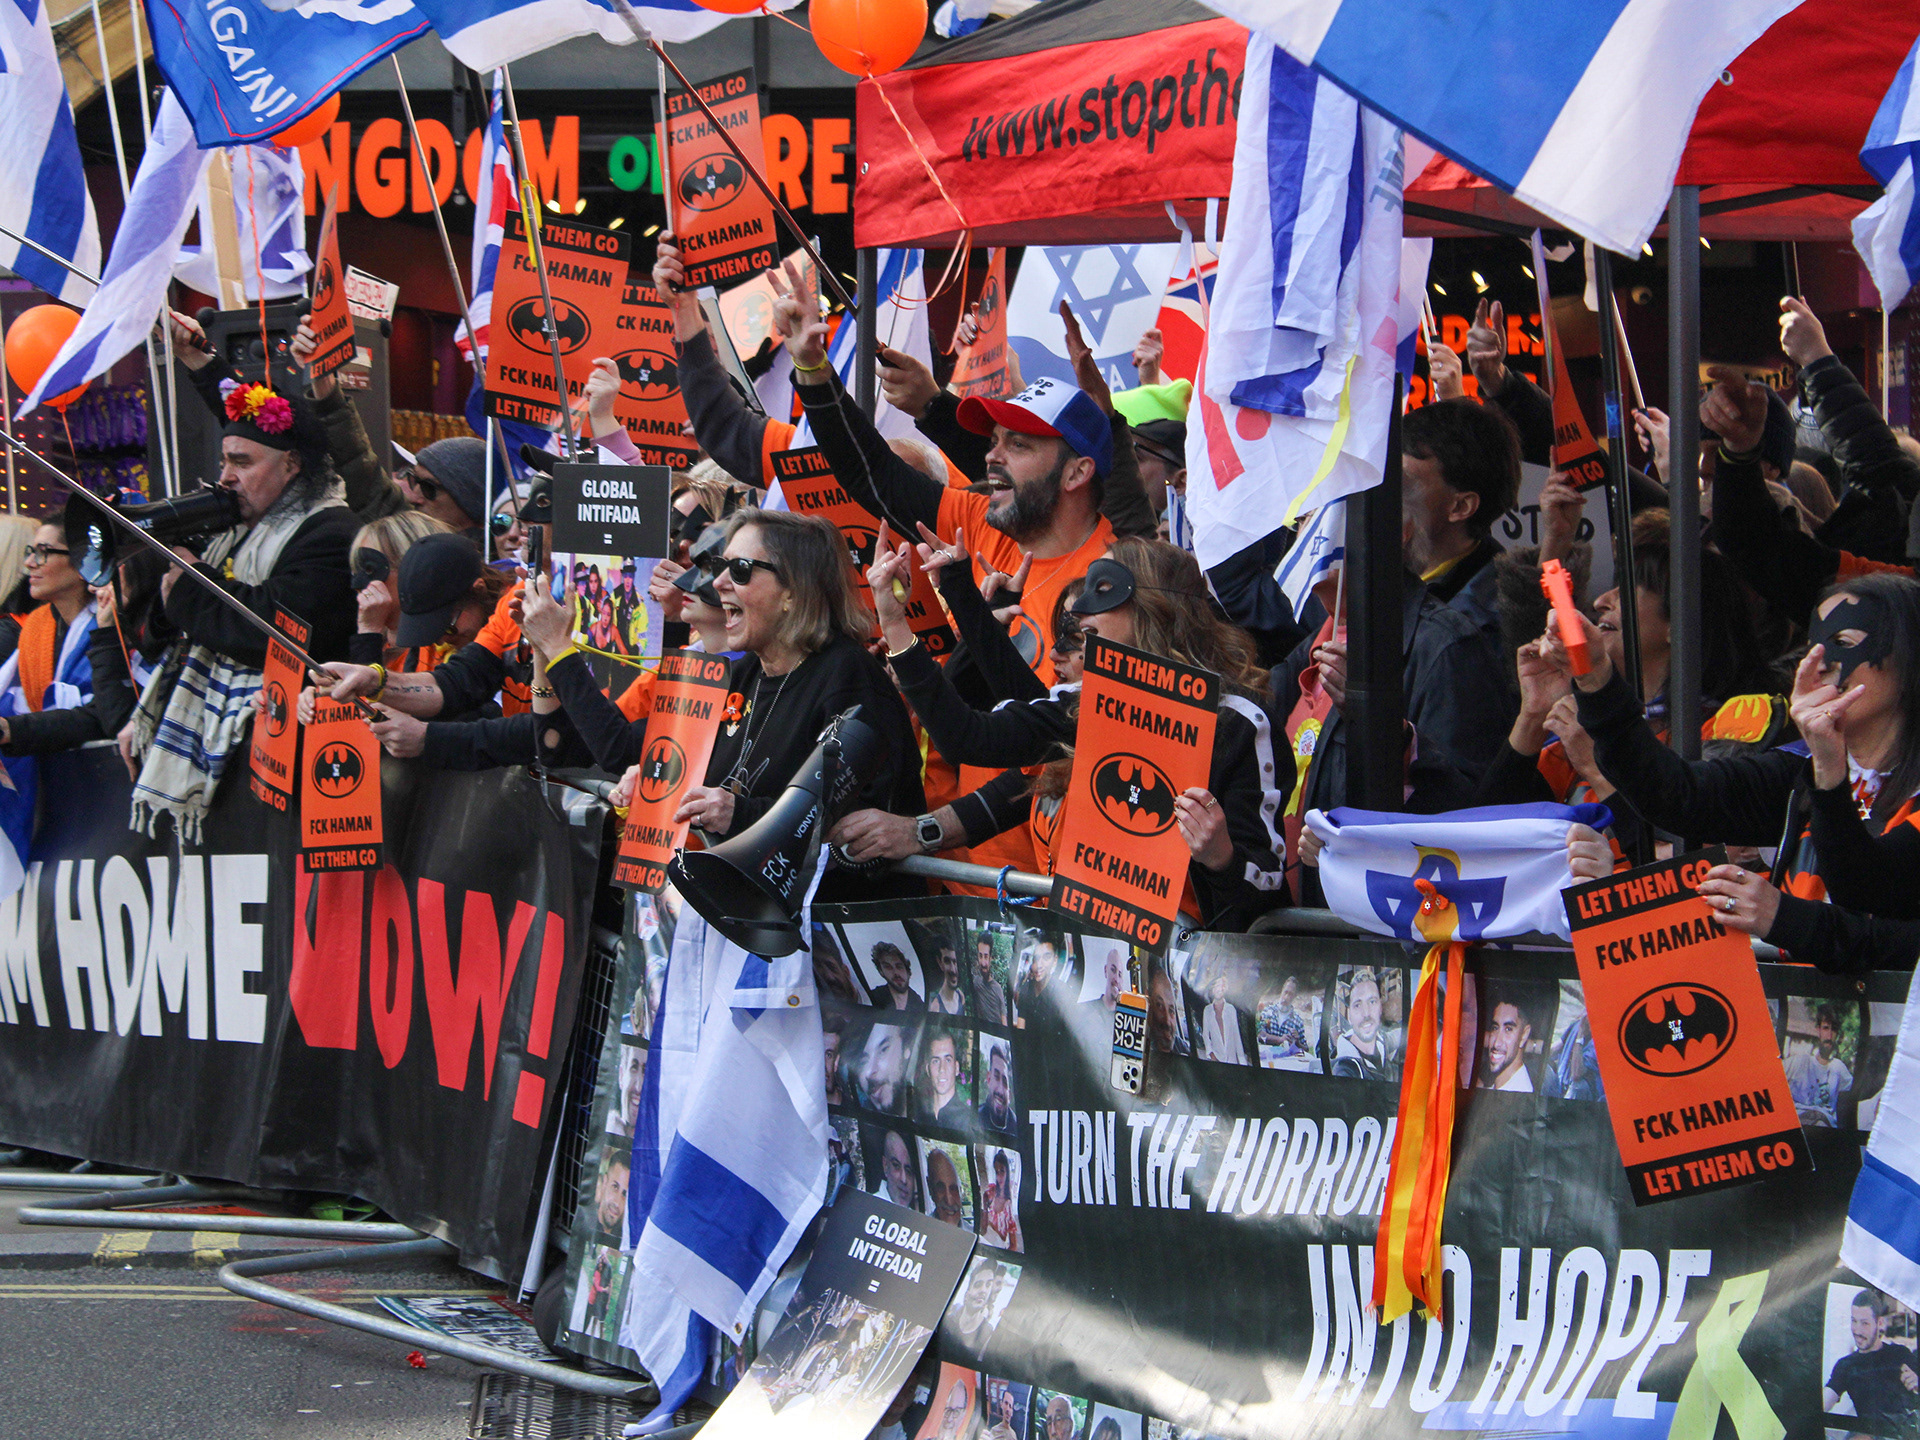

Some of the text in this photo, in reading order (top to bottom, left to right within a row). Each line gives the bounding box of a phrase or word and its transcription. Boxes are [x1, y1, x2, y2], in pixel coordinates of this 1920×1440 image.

[206, 0, 297, 123] GAIN!
[726, 76, 746, 92] GO
[669, 125, 694, 147] FCK
[545, 224, 592, 248] THEM
[595, 234, 619, 254] GO
[680, 218, 763, 254] FCK HAMAN
[513, 254, 612, 288] FC HAMAN
[684, 251, 771, 288] LET THEM GO
[637, 284, 664, 304] THE
[323, 314, 347, 340] HAMAN
[616, 315, 675, 335] CK HAM
[310, 342, 353, 379] LET THEM GO
[500, 365, 529, 387] FCK
[496, 398, 523, 417] LET
[633, 416, 686, 437] HAMAN
[1557, 421, 1582, 447] MAN
[641, 449, 688, 468] EM GO
[779, 452, 831, 476] LET TH
[1583, 460, 1605, 482] GO
[581, 479, 638, 500] GLOBAL
[796, 490, 824, 511] FCK
[577, 503, 641, 525] INTIFADA
[297, 625, 308, 644] GO
[921, 633, 945, 653] O
[661, 655, 725, 682] LET THEM GO
[1095, 645, 1207, 701] LET THEM GO
[328, 704, 365, 723] HAMA
[665, 696, 713, 720] HAMAN
[1095, 693, 1199, 748] FCK HAMAN
[262, 751, 287, 780] HAMAN
[273, 792, 287, 812] GO
[310, 815, 372, 835] FCK HAMAN
[635, 826, 675, 849] HAMAN
[309, 849, 377, 869] LET THEM GO
[762, 851, 791, 886] FCK
[1074, 842, 1171, 900] FCK HAMAN
[624, 863, 646, 886] THEM
[646, 867, 665, 889] GO
[1576, 859, 1713, 920] LET THEM GO
[1060, 885, 1162, 946] LET THEM GO
[1596, 914, 1727, 970] FCK HAMAN
[54, 853, 269, 1045] HOME
[288, 853, 566, 1130] NOW!
[1114, 1028, 1144, 1052] FCK
[1633, 1088, 1775, 1144] FCK HAMAN
[1027, 1109, 1117, 1207] TURN
[1125, 1112, 1210, 1211] THE
[1643, 1140, 1795, 1197] LET THEM GO
[864, 1214, 928, 1256] GLOBAL
[847, 1238, 924, 1284] INTIFADA
[1295, 1243, 1712, 1420] INO HOPE
